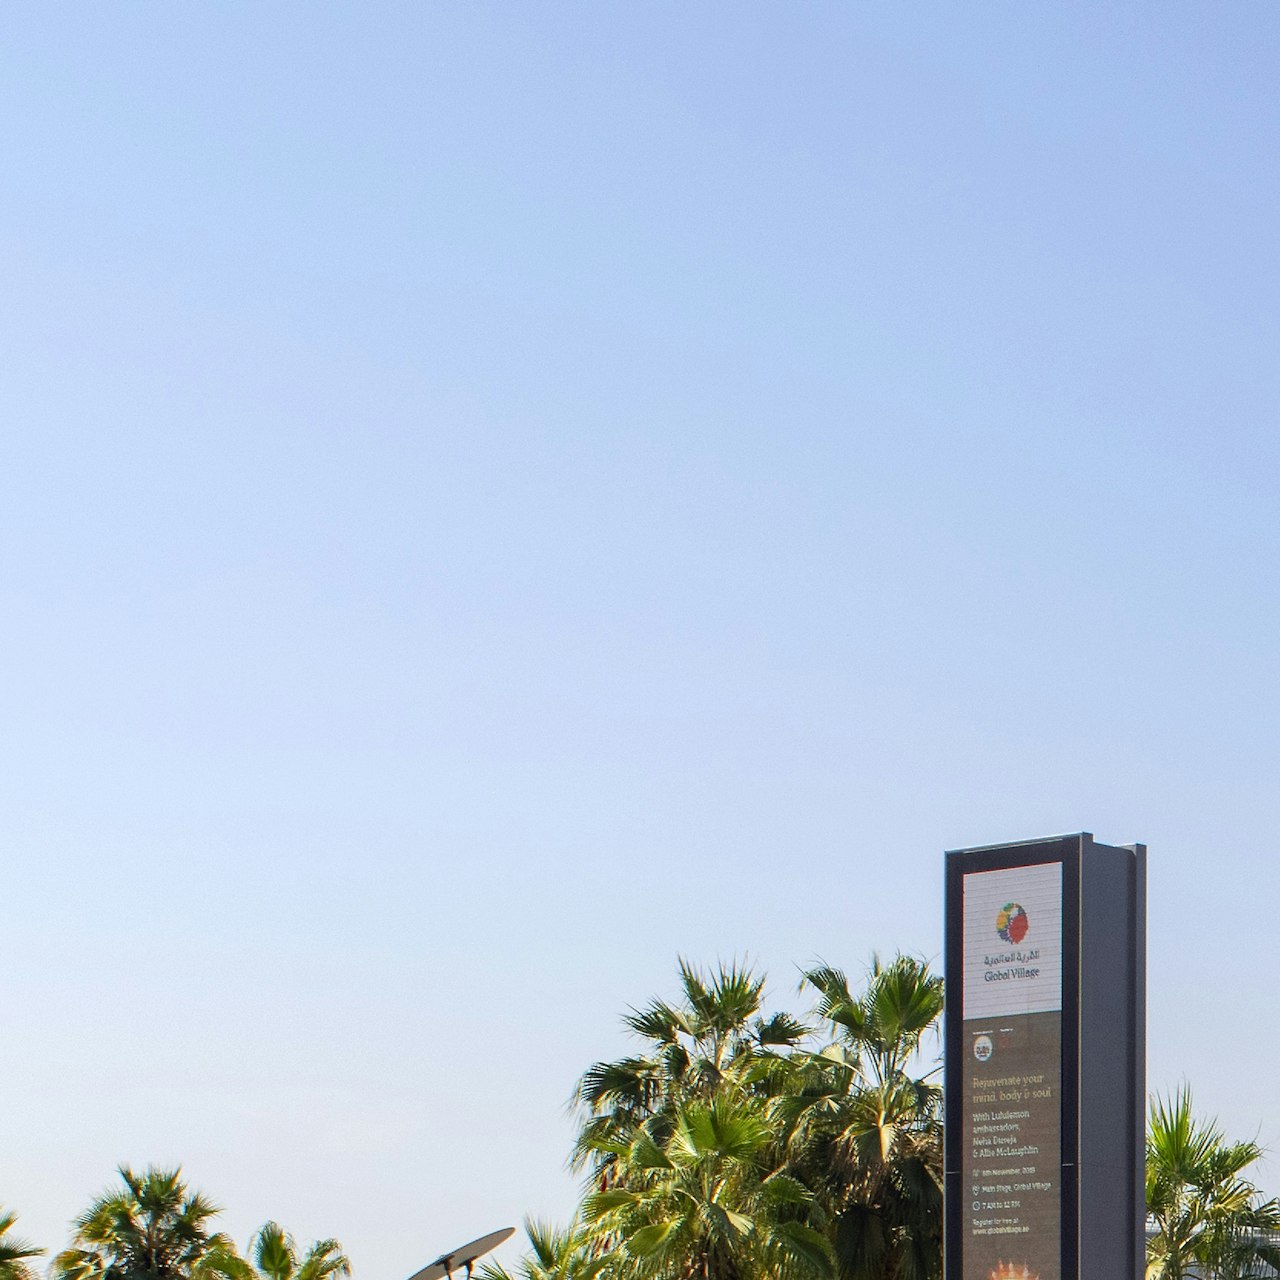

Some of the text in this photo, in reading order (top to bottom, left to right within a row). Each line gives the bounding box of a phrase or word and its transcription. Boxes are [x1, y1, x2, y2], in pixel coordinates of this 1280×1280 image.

[984, 967, 1040, 982] Global Village
[972, 1075, 1044, 1090] Rejuvenate your
[1000, 1089, 1022, 1102] body
[1033, 1086, 1052, 1099] soul
[972, 1112, 990, 1122] With
